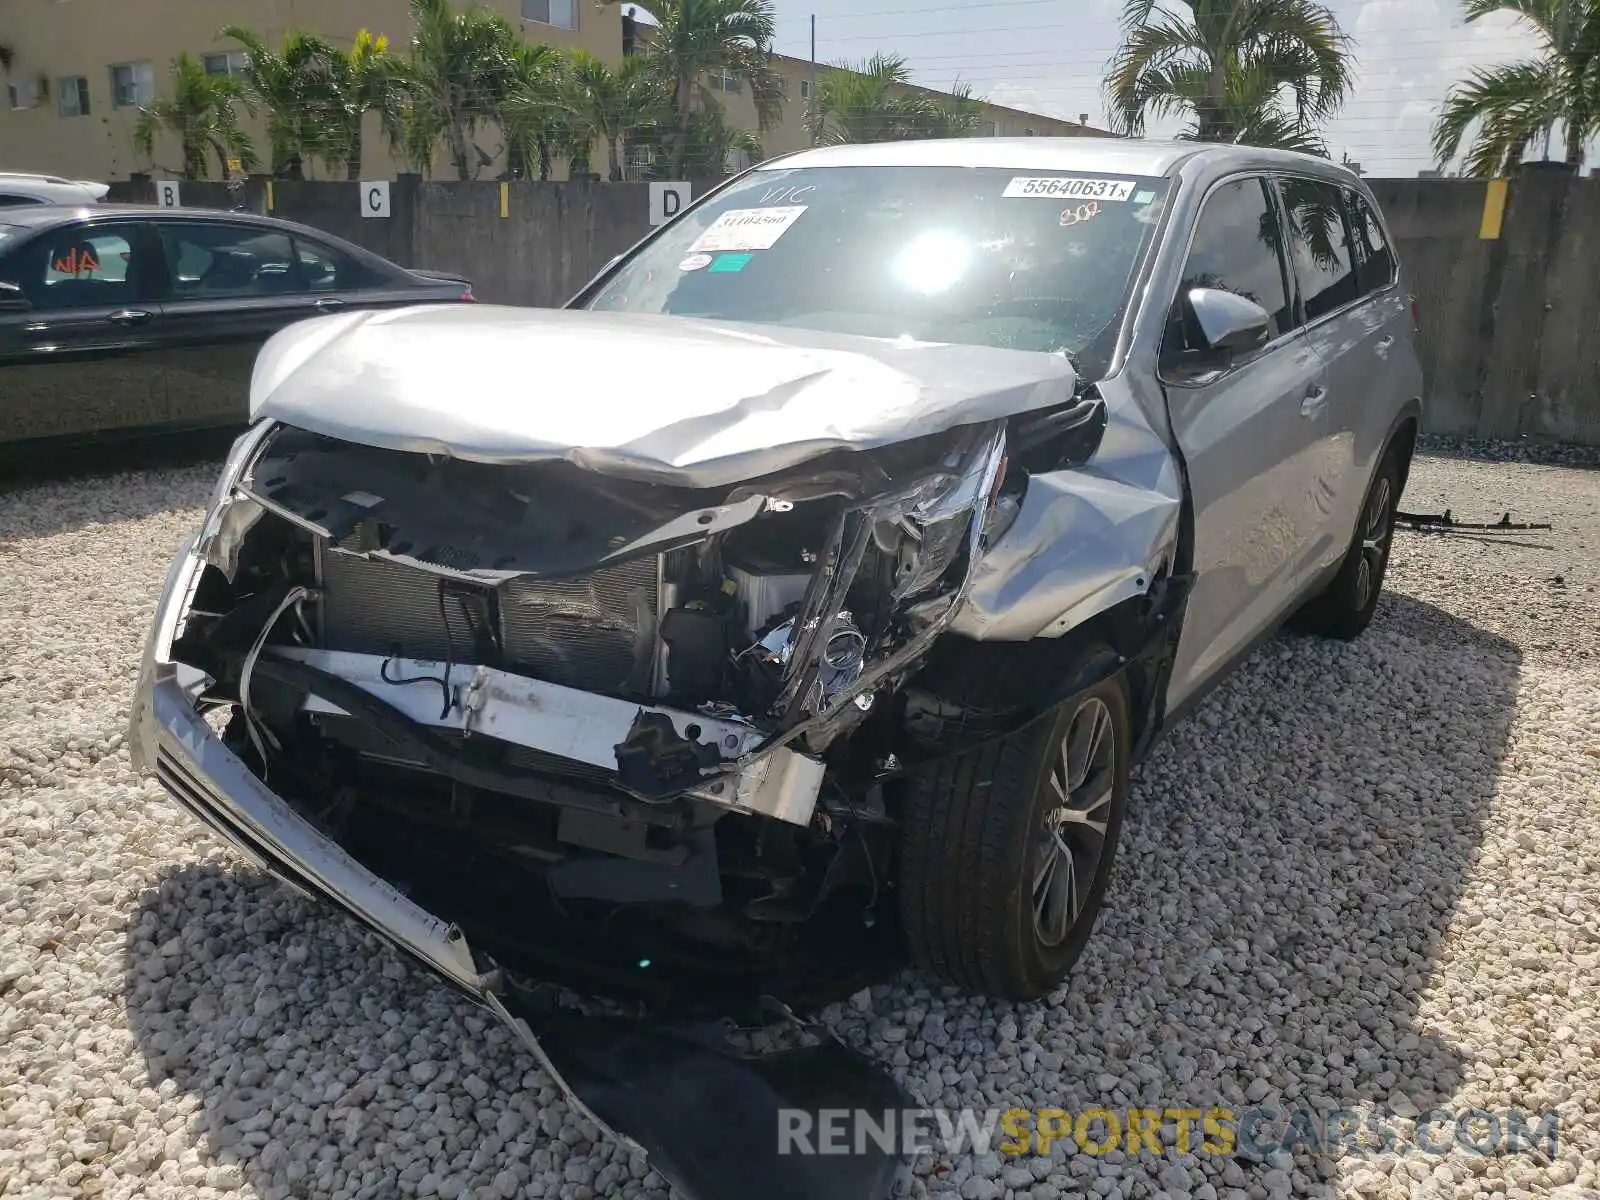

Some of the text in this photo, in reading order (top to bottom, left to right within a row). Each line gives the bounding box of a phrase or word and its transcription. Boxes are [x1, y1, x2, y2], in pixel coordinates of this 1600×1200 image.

[164, 186, 174, 206] B
[369, 188, 381, 211] C
[663, 190, 680, 217] D
